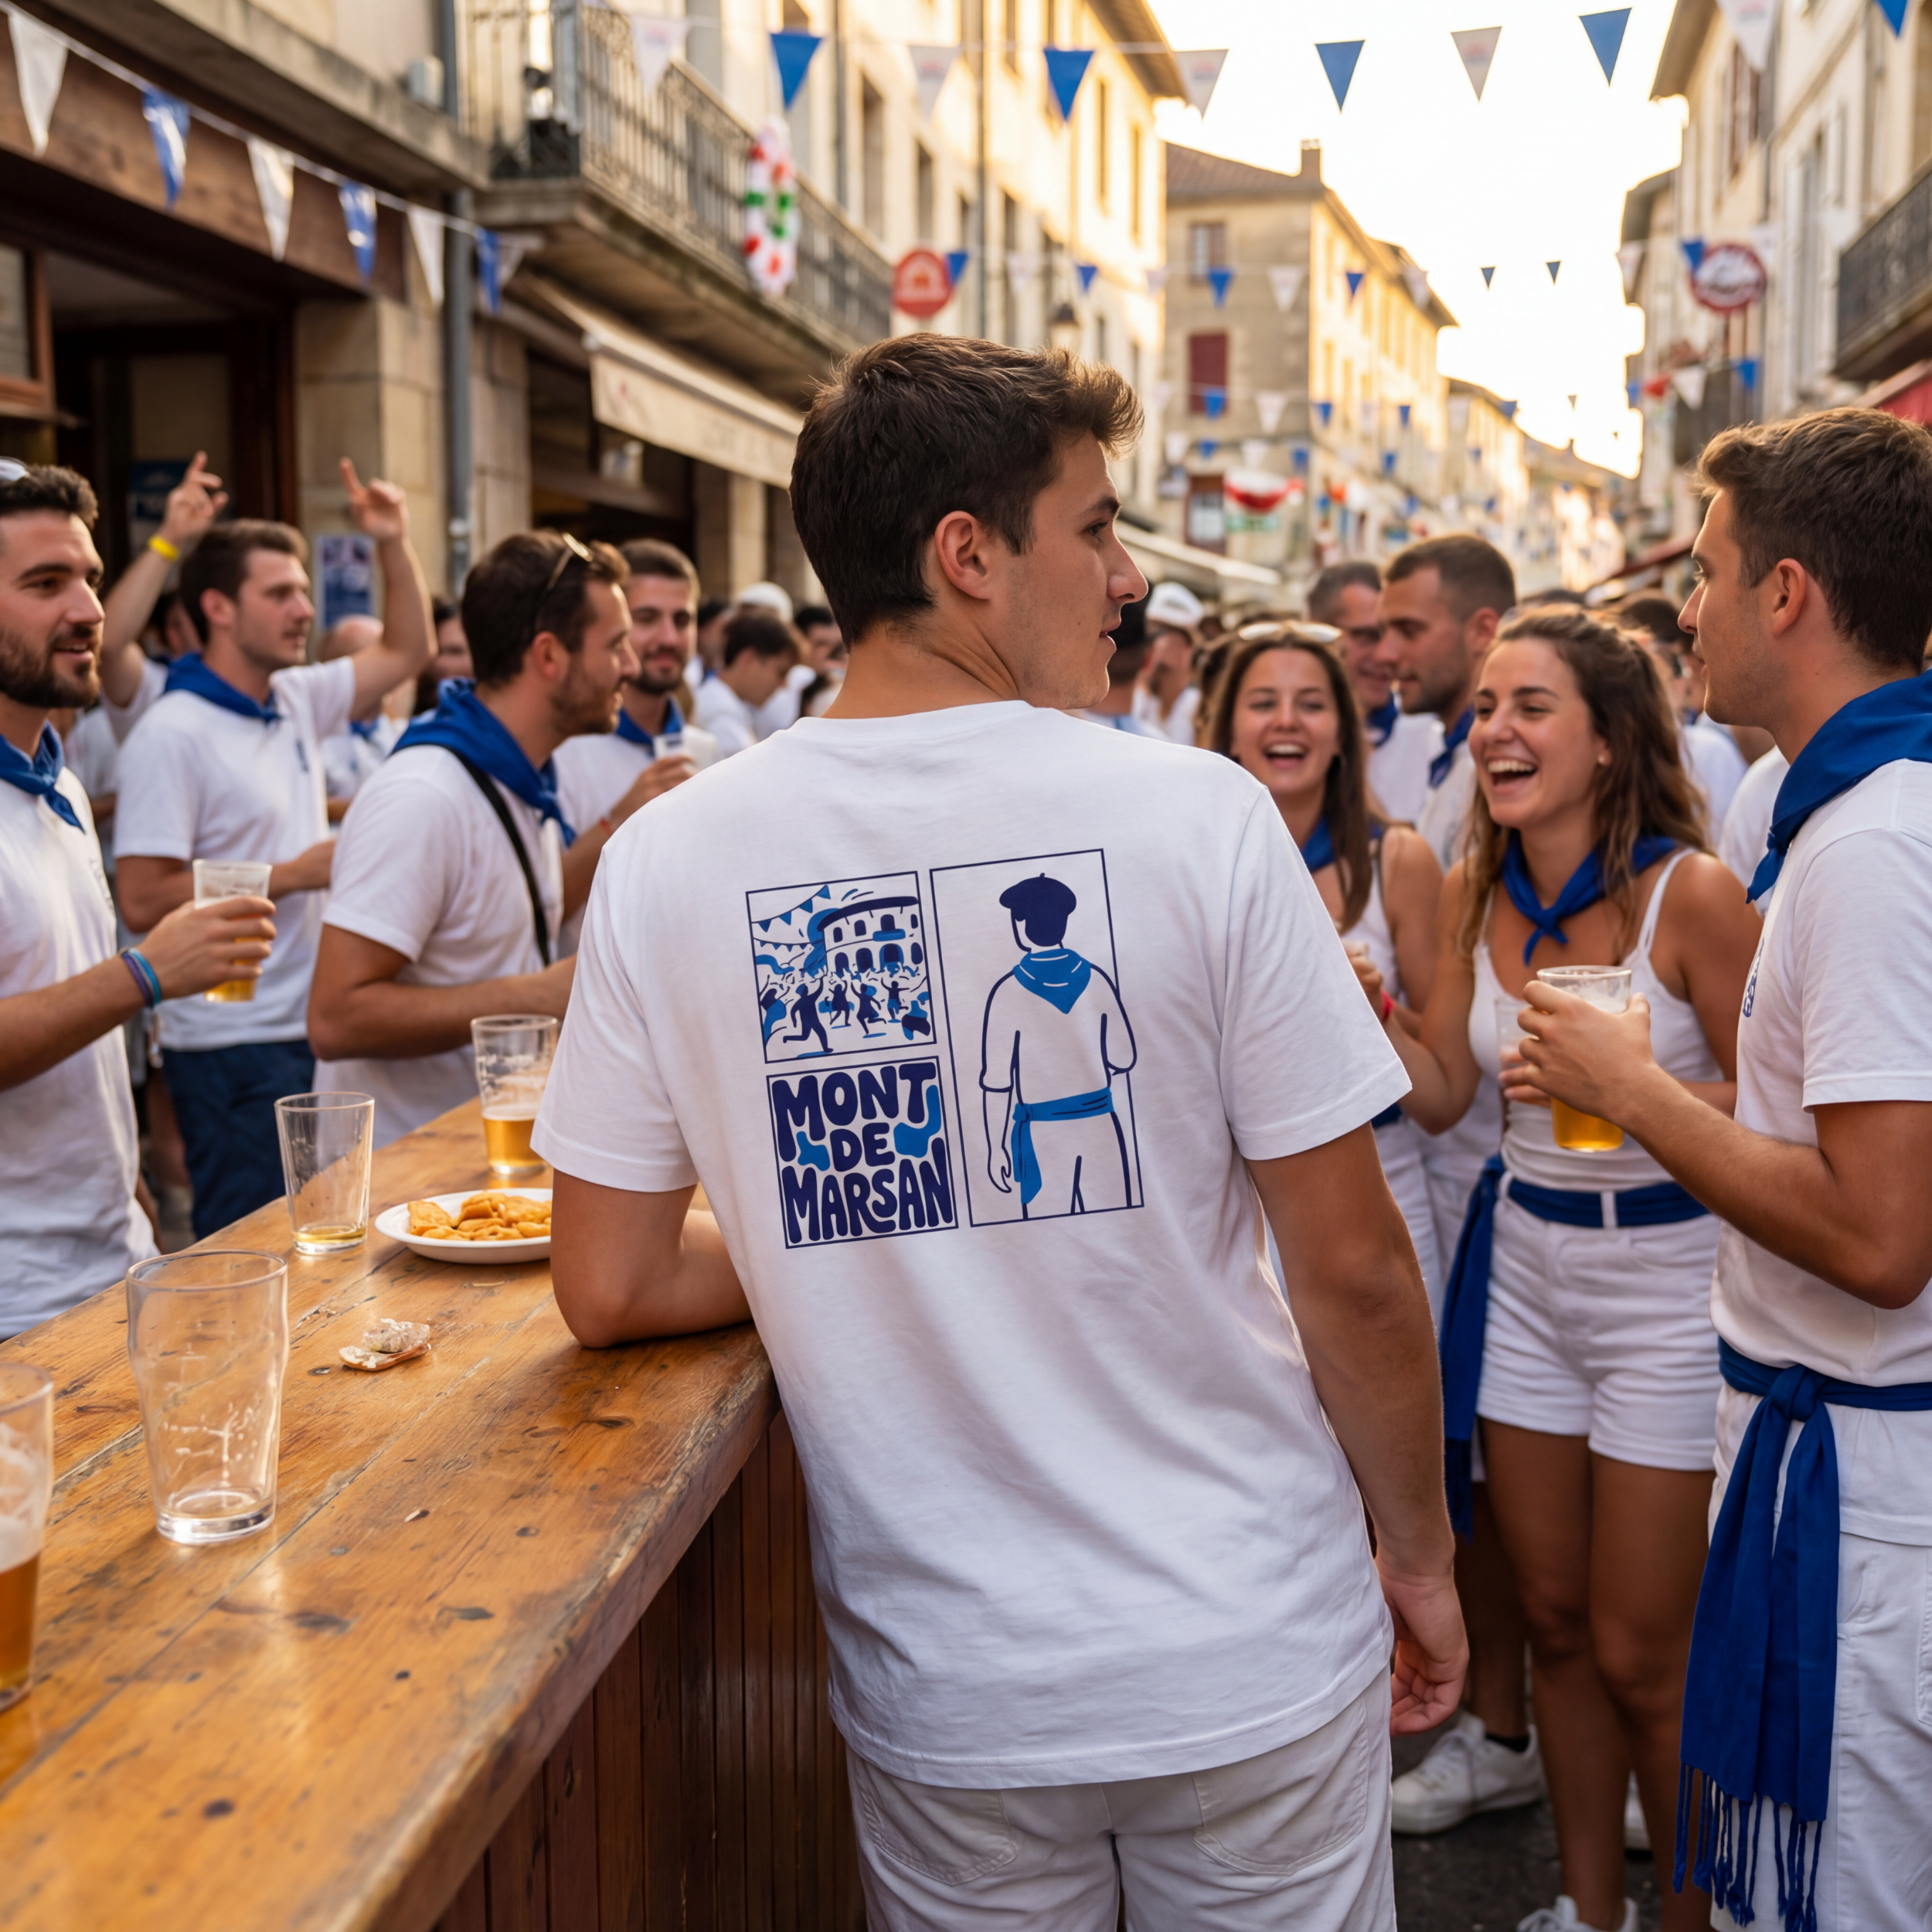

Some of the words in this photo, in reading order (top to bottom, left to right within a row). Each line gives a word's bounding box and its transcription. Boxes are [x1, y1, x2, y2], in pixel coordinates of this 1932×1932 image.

[771, 1062, 937, 1162] MONT
[830, 1122, 896, 1172] DE
[781, 1138, 953, 1243] MARSAN
